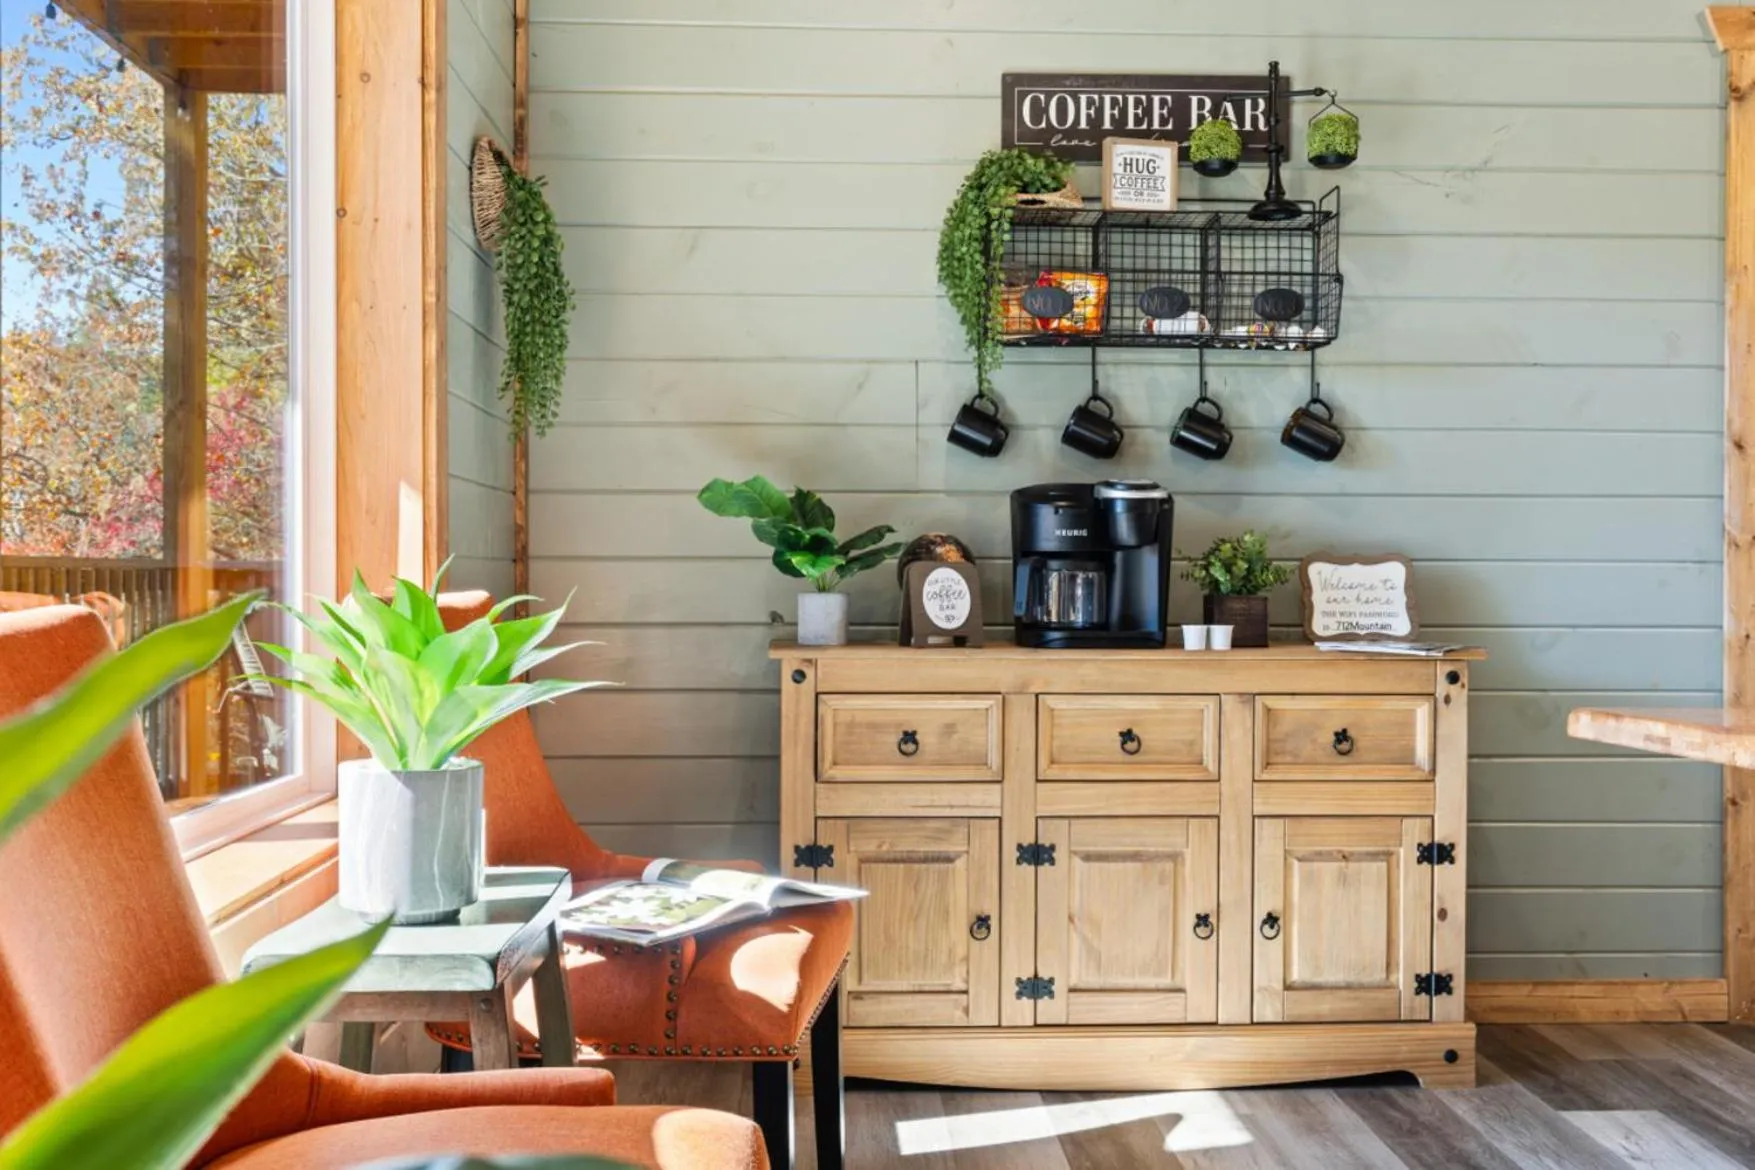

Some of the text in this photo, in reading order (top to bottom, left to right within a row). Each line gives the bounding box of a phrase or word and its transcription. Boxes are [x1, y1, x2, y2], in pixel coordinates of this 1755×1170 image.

[1022, 92, 1269, 132] COFFEE BAR
[1123, 156, 1157, 175] HUG
[1119, 176, 1160, 190] COFFEE
[1054, 528, 1088, 537] KEURIG
[1316, 567, 1398, 592] Welcome to
[1325, 592, 1394, 606] our home
[1335, 620, 1392, 632] 712Mountain
